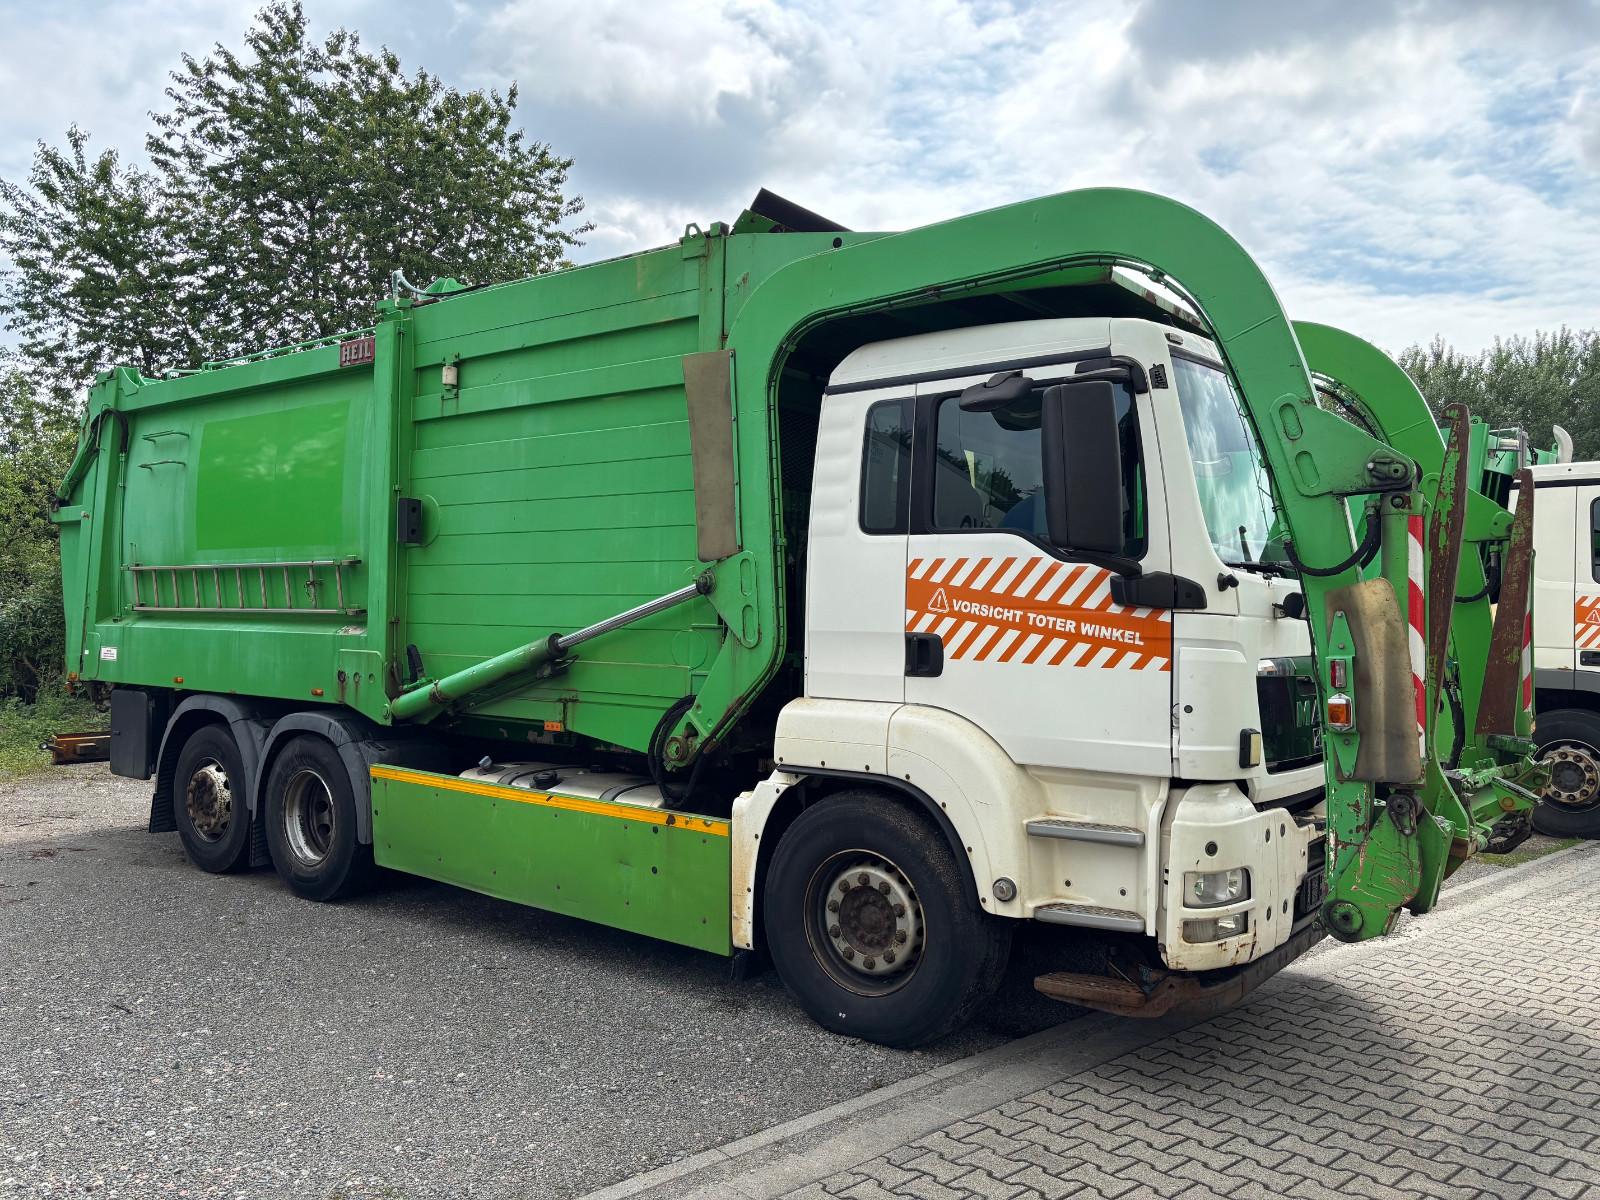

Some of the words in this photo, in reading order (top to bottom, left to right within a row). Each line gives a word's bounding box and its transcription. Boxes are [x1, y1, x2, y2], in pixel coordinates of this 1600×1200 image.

[342, 342, 371, 362] HEIL
[952, 598, 1023, 623] VORSICHT
[1027, 613, 1076, 634] TOTER
[1080, 623, 1145, 646] WINKEL
